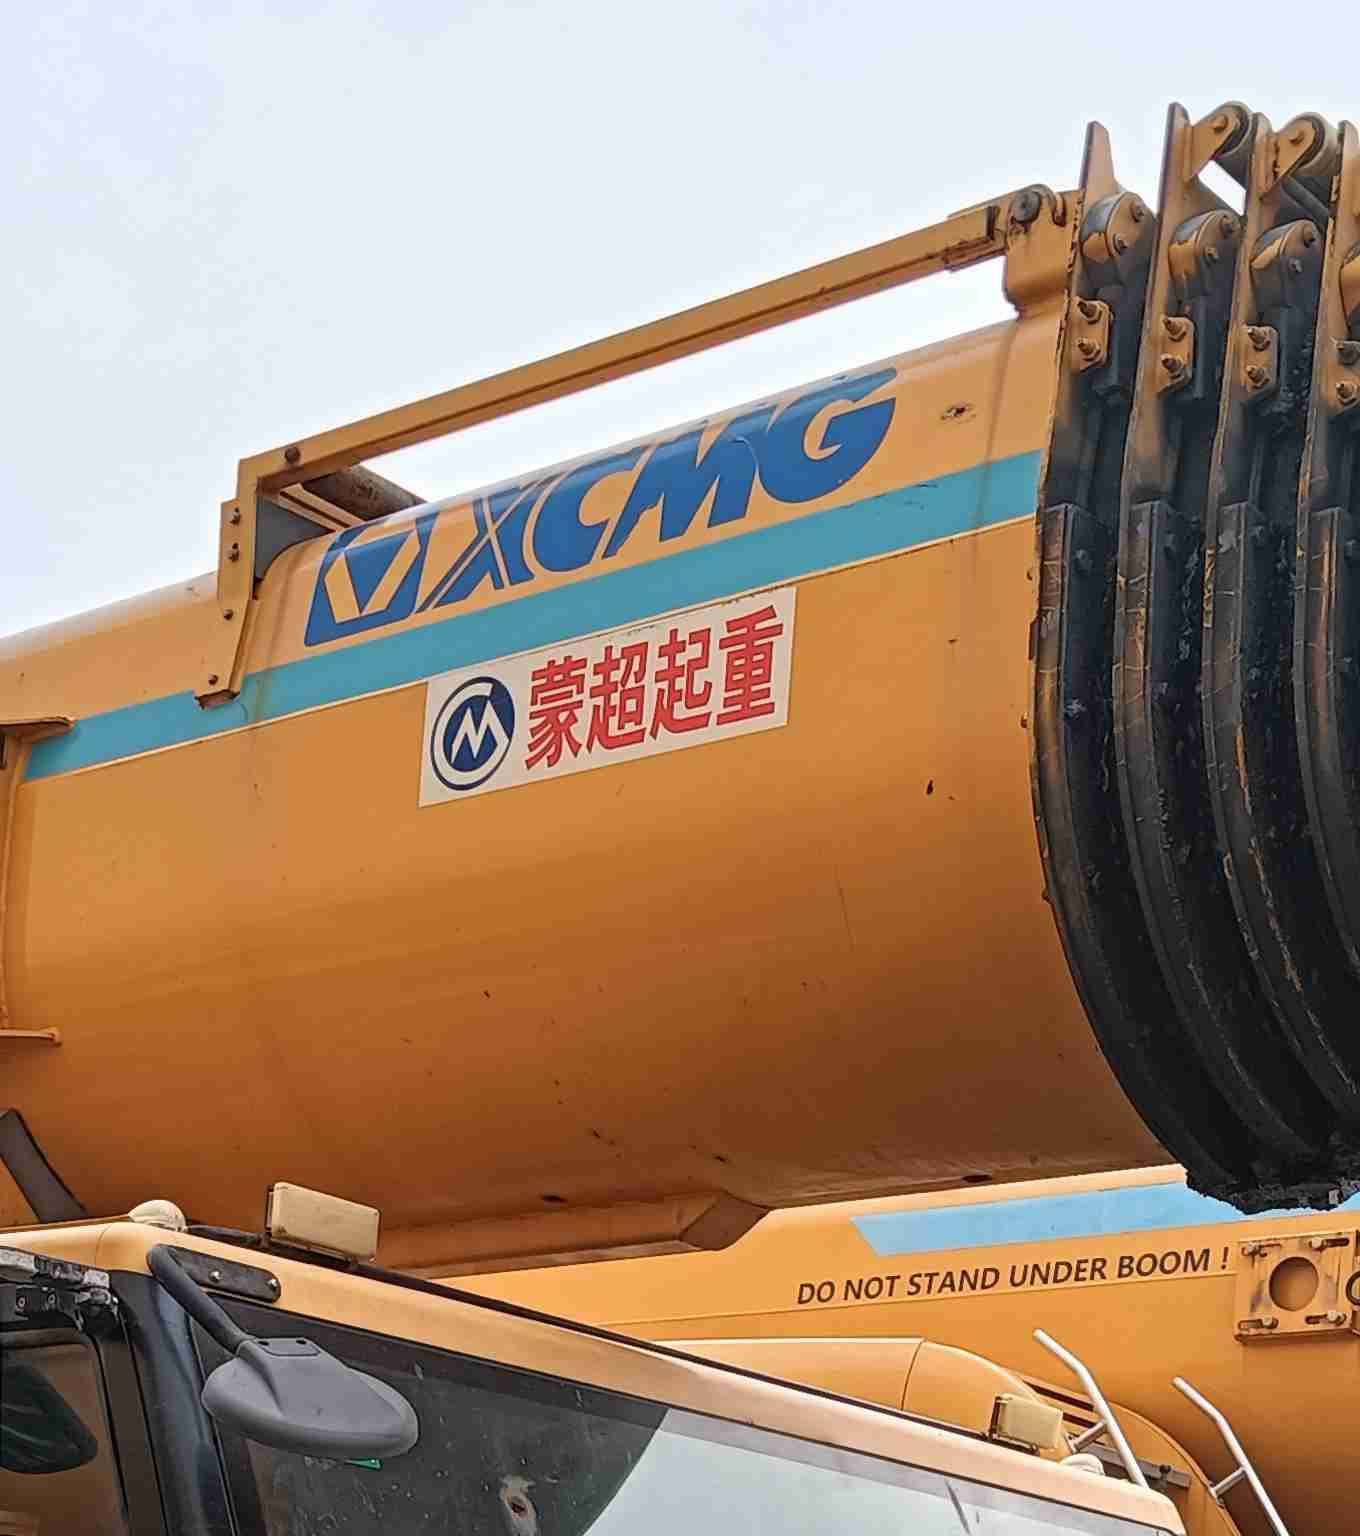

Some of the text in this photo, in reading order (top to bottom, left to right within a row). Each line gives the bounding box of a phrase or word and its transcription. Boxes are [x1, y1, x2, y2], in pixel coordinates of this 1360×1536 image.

[418, 367, 897, 612] XCMG
[525, 604, 785, 770] 蒙超起重
[796, 1280, 838, 1306] DO
[842, 1274, 901, 1301] NOT
[905, 1266, 1001, 1296] STAND
[1008, 1257, 1108, 1288] UNDER
[1116, 1248, 1211, 1278] BOOM
